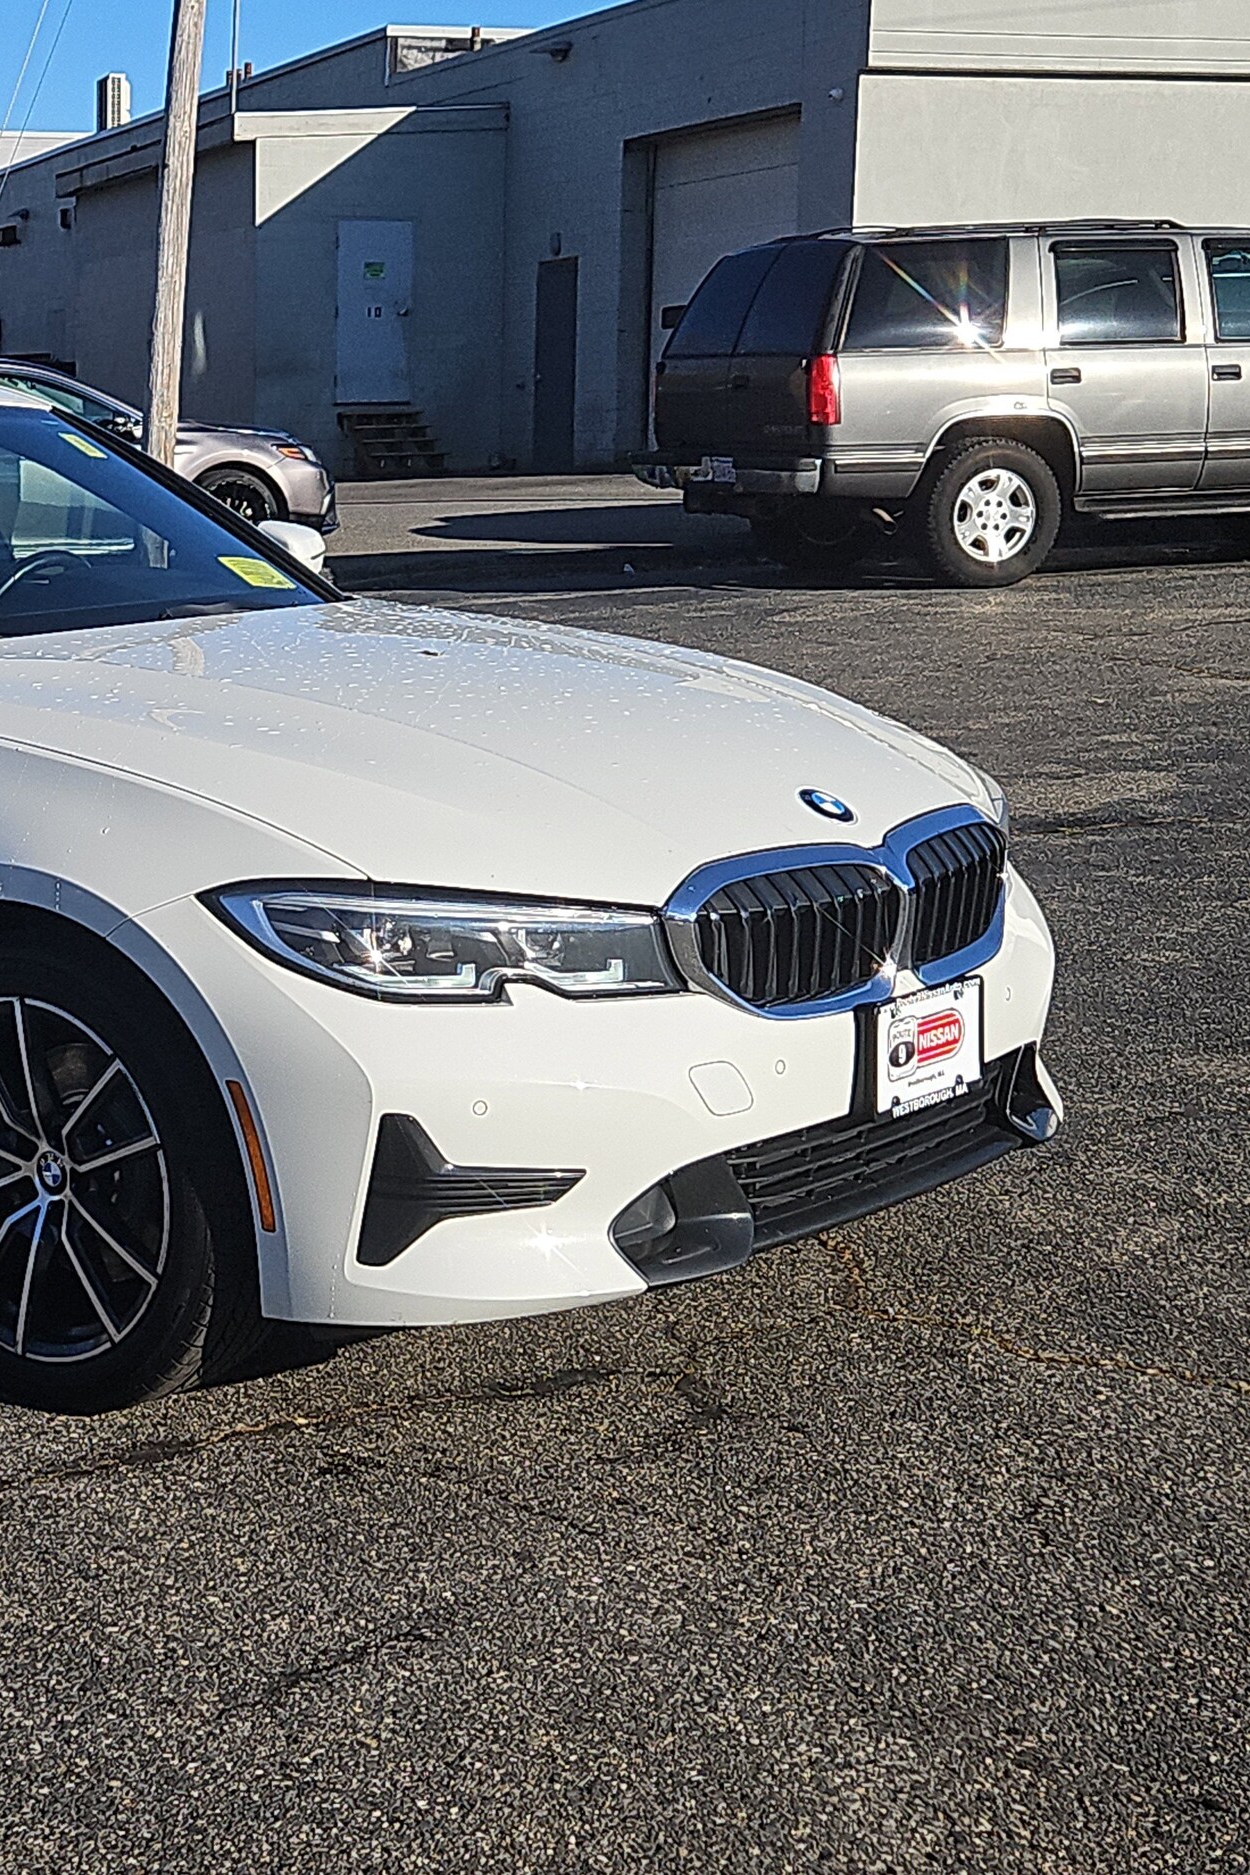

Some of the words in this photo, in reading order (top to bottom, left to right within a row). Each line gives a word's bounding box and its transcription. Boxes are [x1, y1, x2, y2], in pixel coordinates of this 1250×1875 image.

[918, 1023, 960, 1051] NISSAN
[898, 1043, 907, 1065] 9
[955, 1082, 970, 1096] MA
